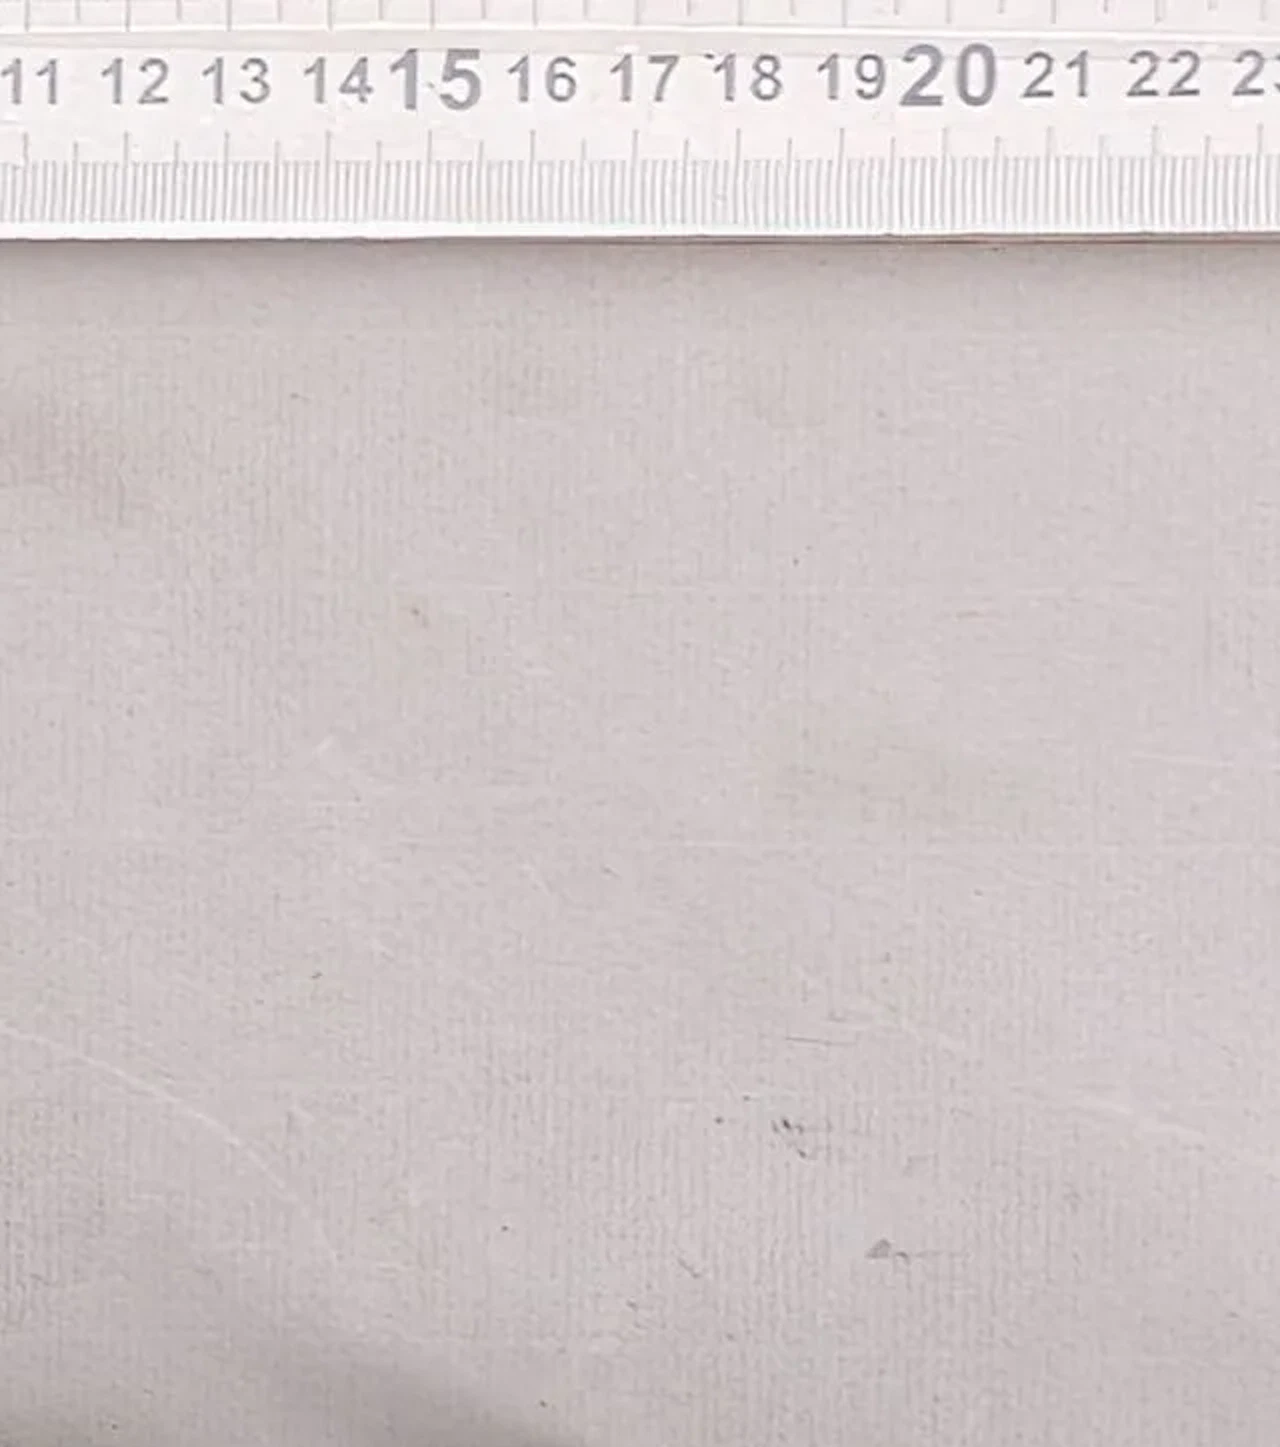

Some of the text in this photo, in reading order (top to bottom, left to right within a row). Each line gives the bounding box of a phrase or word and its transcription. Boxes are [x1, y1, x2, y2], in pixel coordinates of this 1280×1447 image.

[0, 58, 57, 105] 11
[101, 57, 169, 105] 12
[202, 57, 270, 105] 13
[304, 56, 374, 104] 14
[389, 48, 481, 111] 15
[507, 54, 577, 103] 16
[610, 53, 680, 102] 17
[713, 53, 783, 102] 18
[817, 52, 886, 101] 19
[899, 43, 997, 107] 20
[1020, 50, 1089, 98] 21
[1126, 49, 1202, 97] 22
